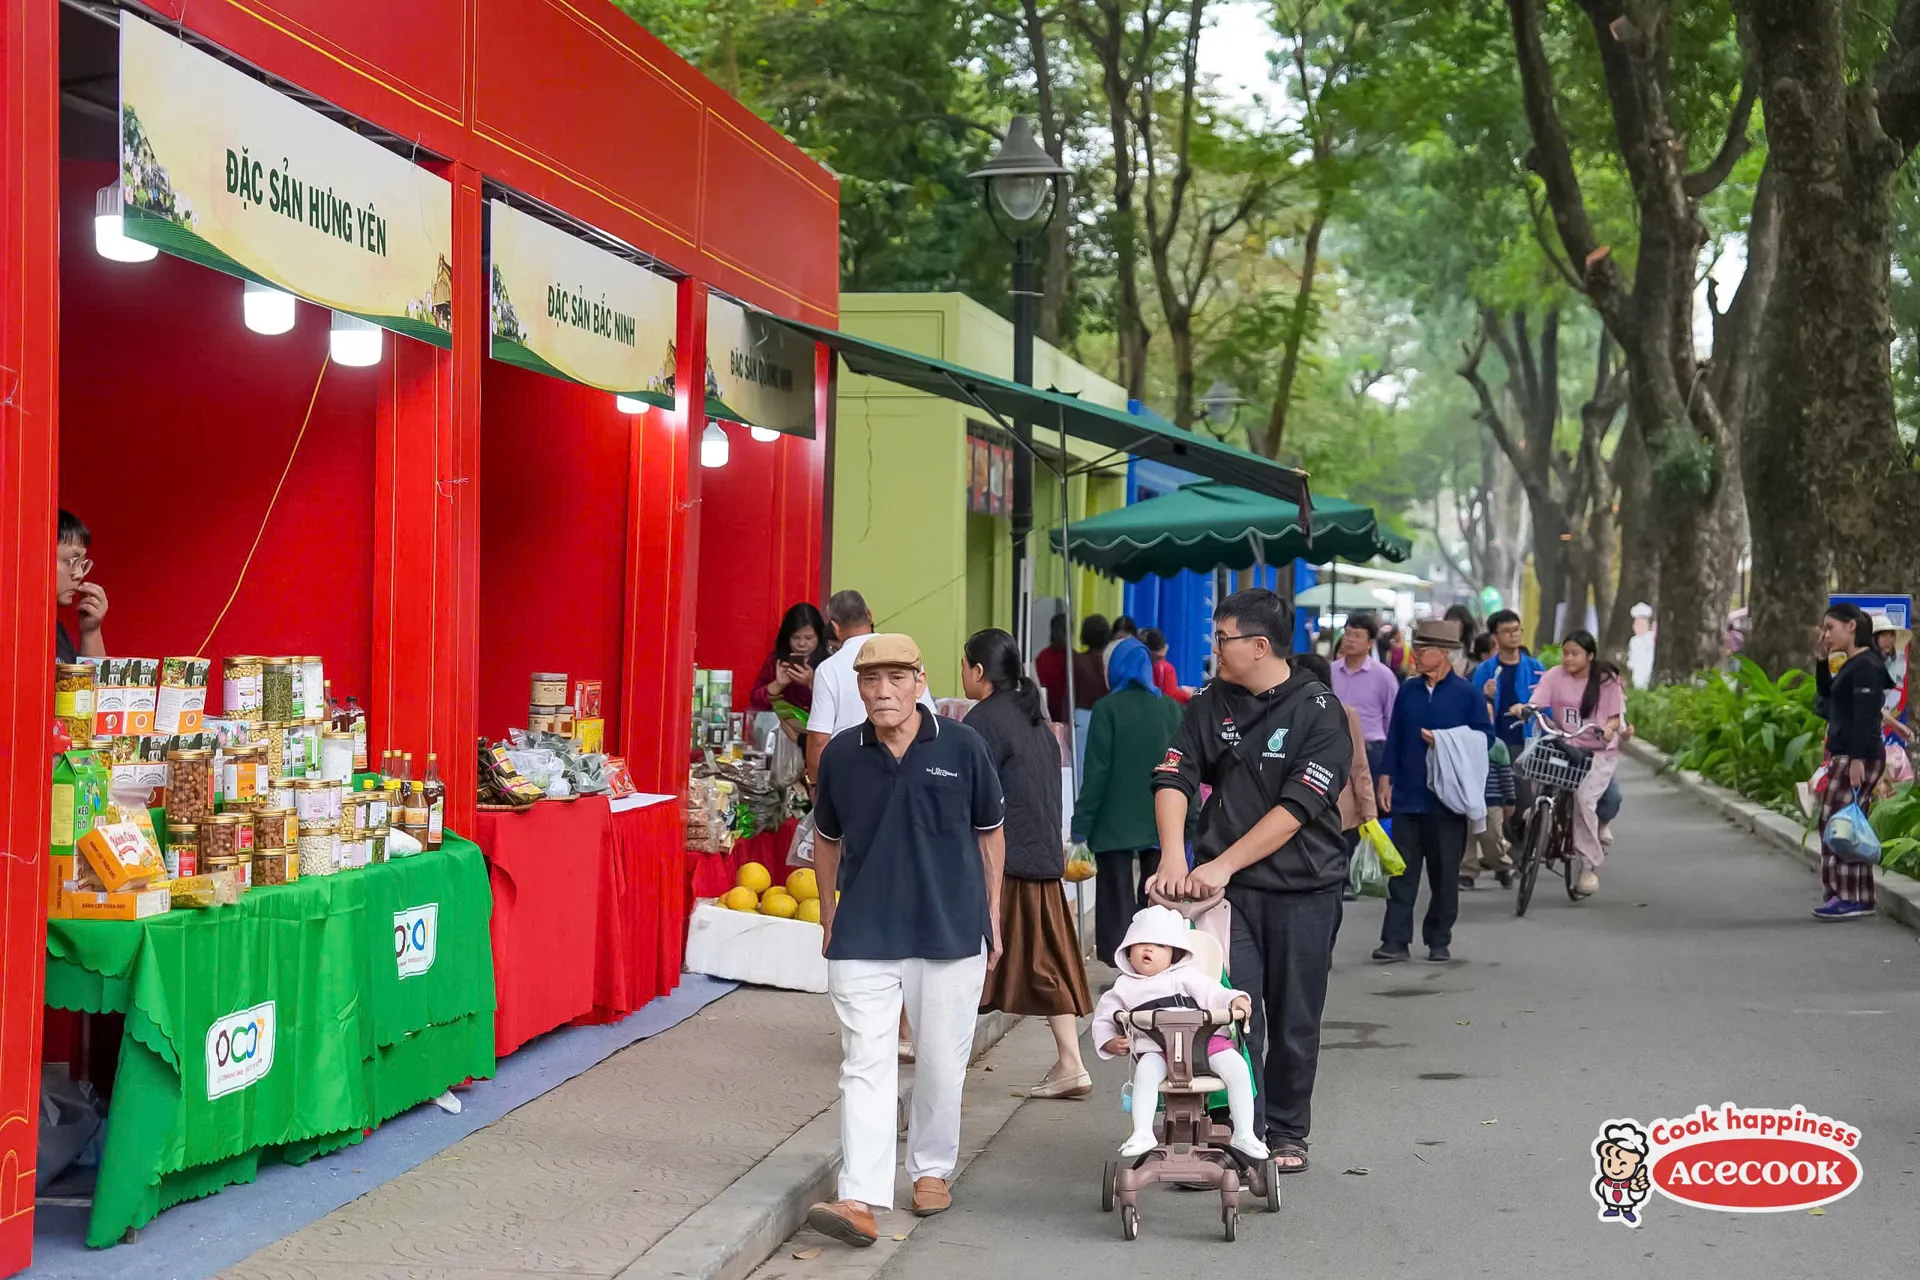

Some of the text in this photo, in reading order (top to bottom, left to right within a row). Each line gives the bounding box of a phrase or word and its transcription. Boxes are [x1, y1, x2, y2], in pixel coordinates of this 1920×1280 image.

[226, 146, 386, 257] ĐẶC SẢN HƯNG YÊN
[548, 282, 635, 347] ĐẶC SẢN BẮC NINH
[1261, 751, 1286, 759] PETRONAS
[1308, 761, 1334, 779] PETRONAS
